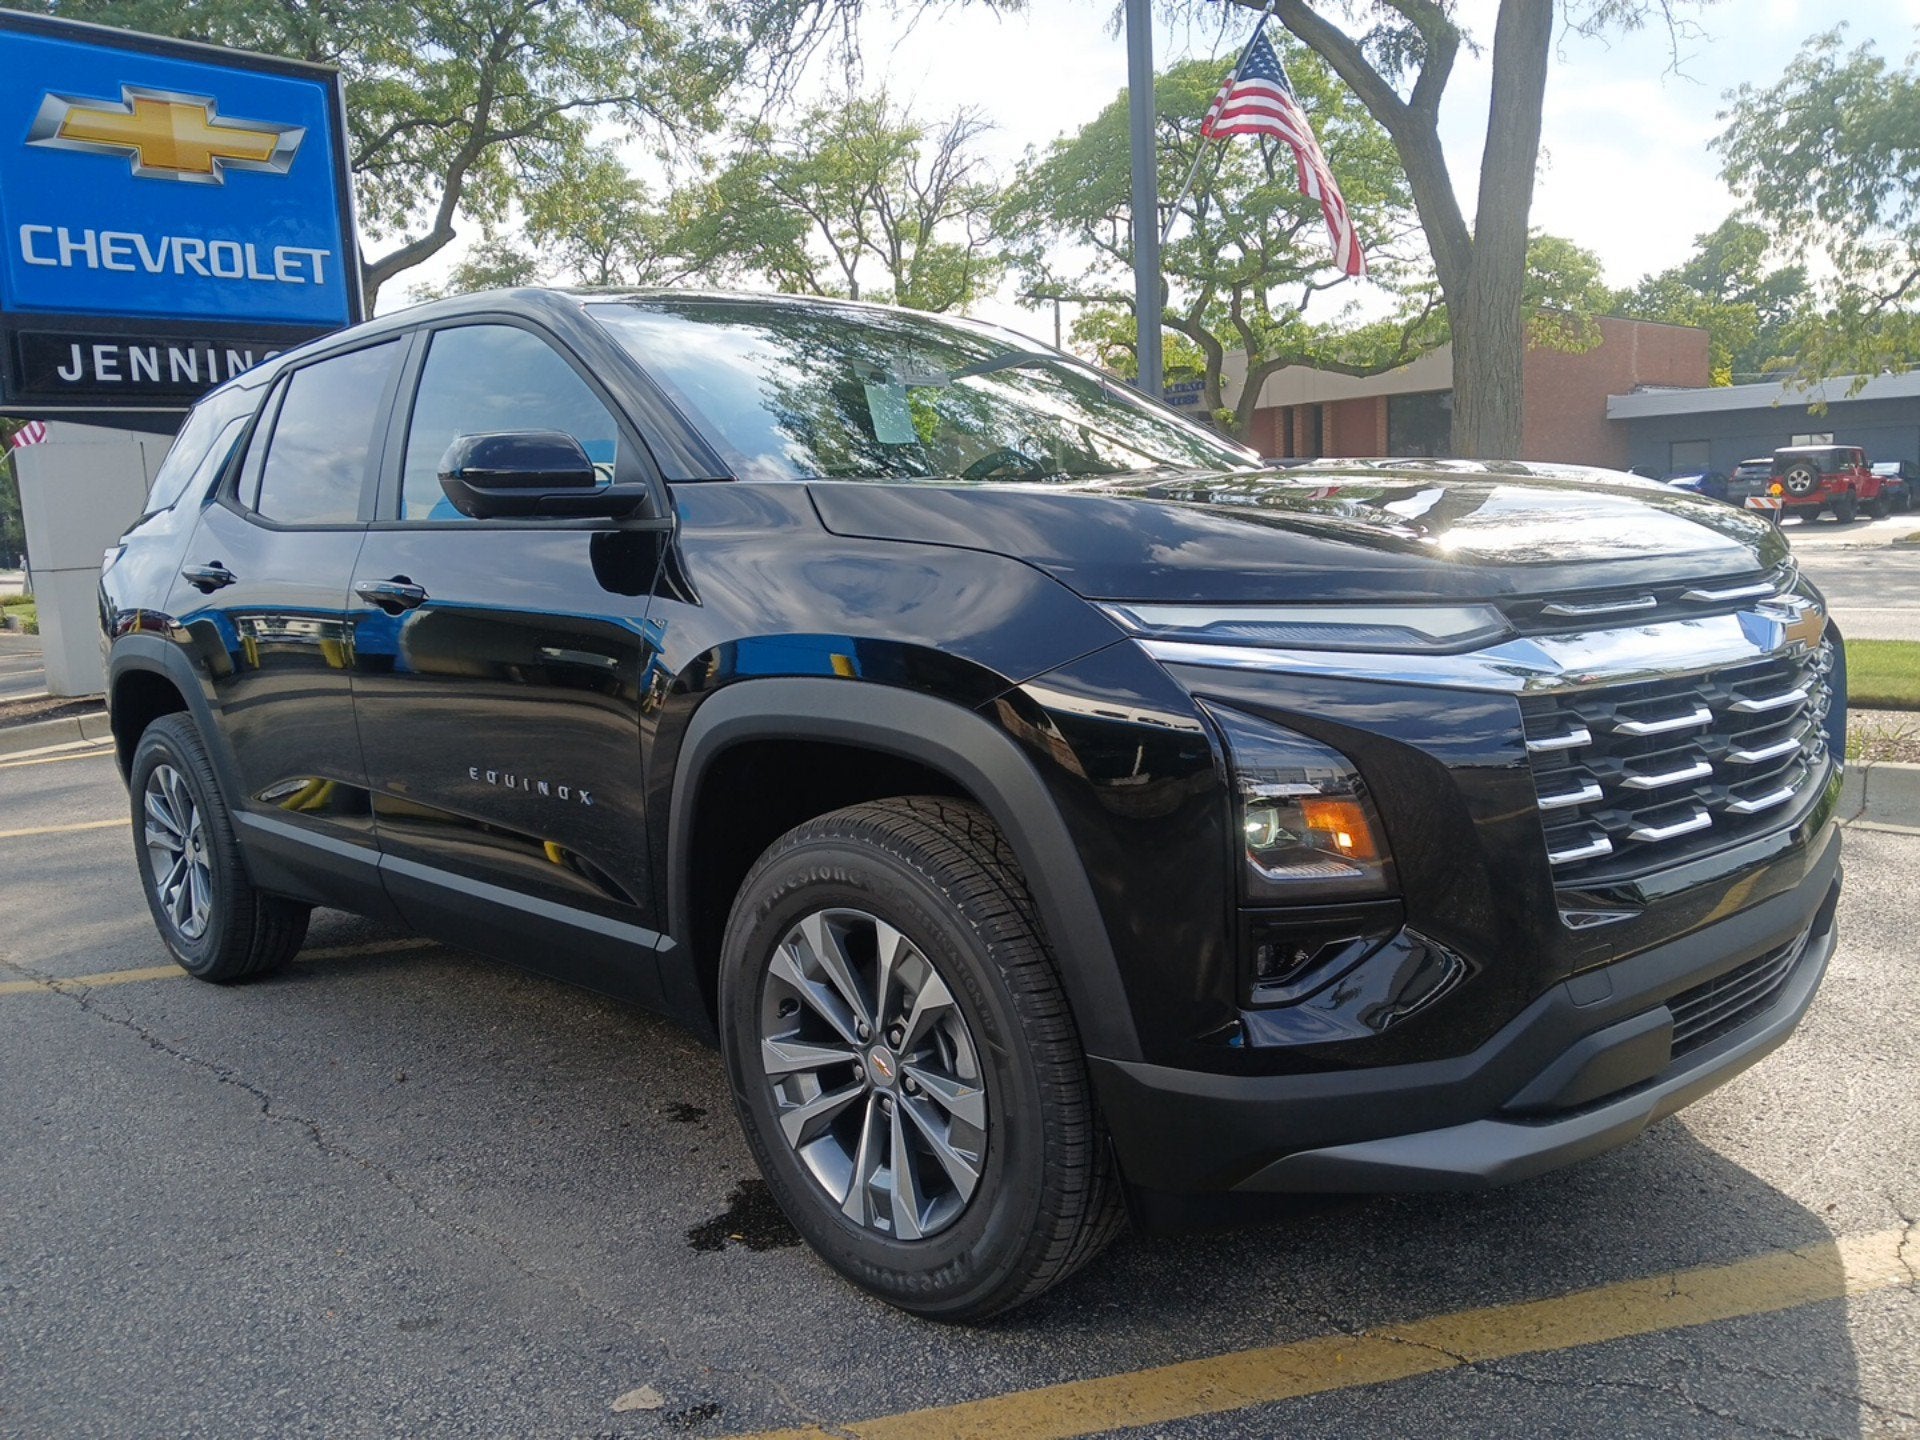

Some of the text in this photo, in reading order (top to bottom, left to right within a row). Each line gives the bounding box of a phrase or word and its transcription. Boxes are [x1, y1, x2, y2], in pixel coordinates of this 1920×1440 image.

[19, 224, 331, 284] CHEVROLET
[57, 343, 282, 383] JENNIN
[468, 766, 594, 806] EQUINOX
